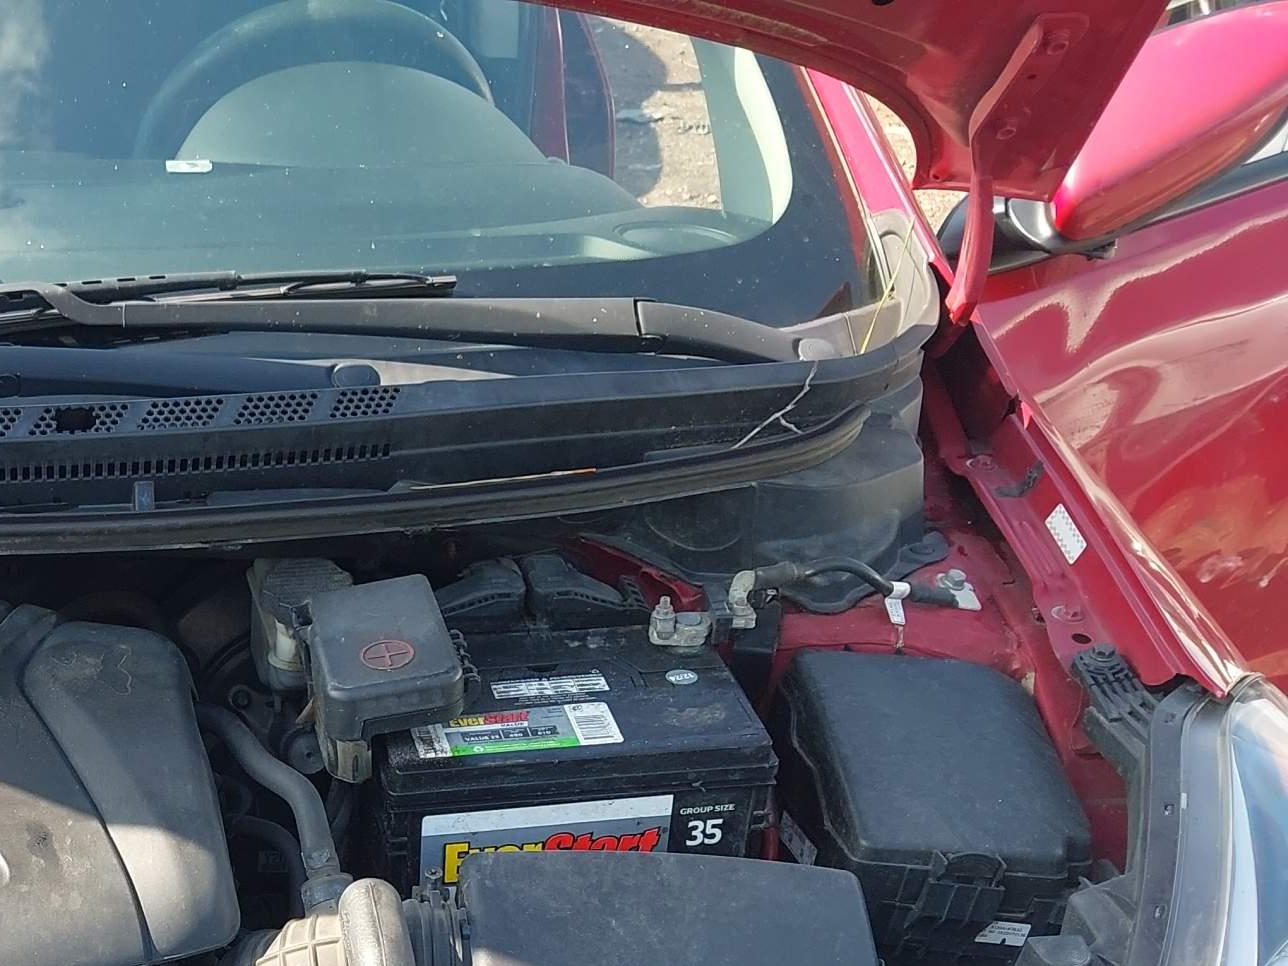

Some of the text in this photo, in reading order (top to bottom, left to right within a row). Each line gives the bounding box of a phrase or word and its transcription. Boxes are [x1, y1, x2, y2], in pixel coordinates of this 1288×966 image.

[680, 803, 736, 815] GROUP SIZE
[686, 818, 723, 846] 35
